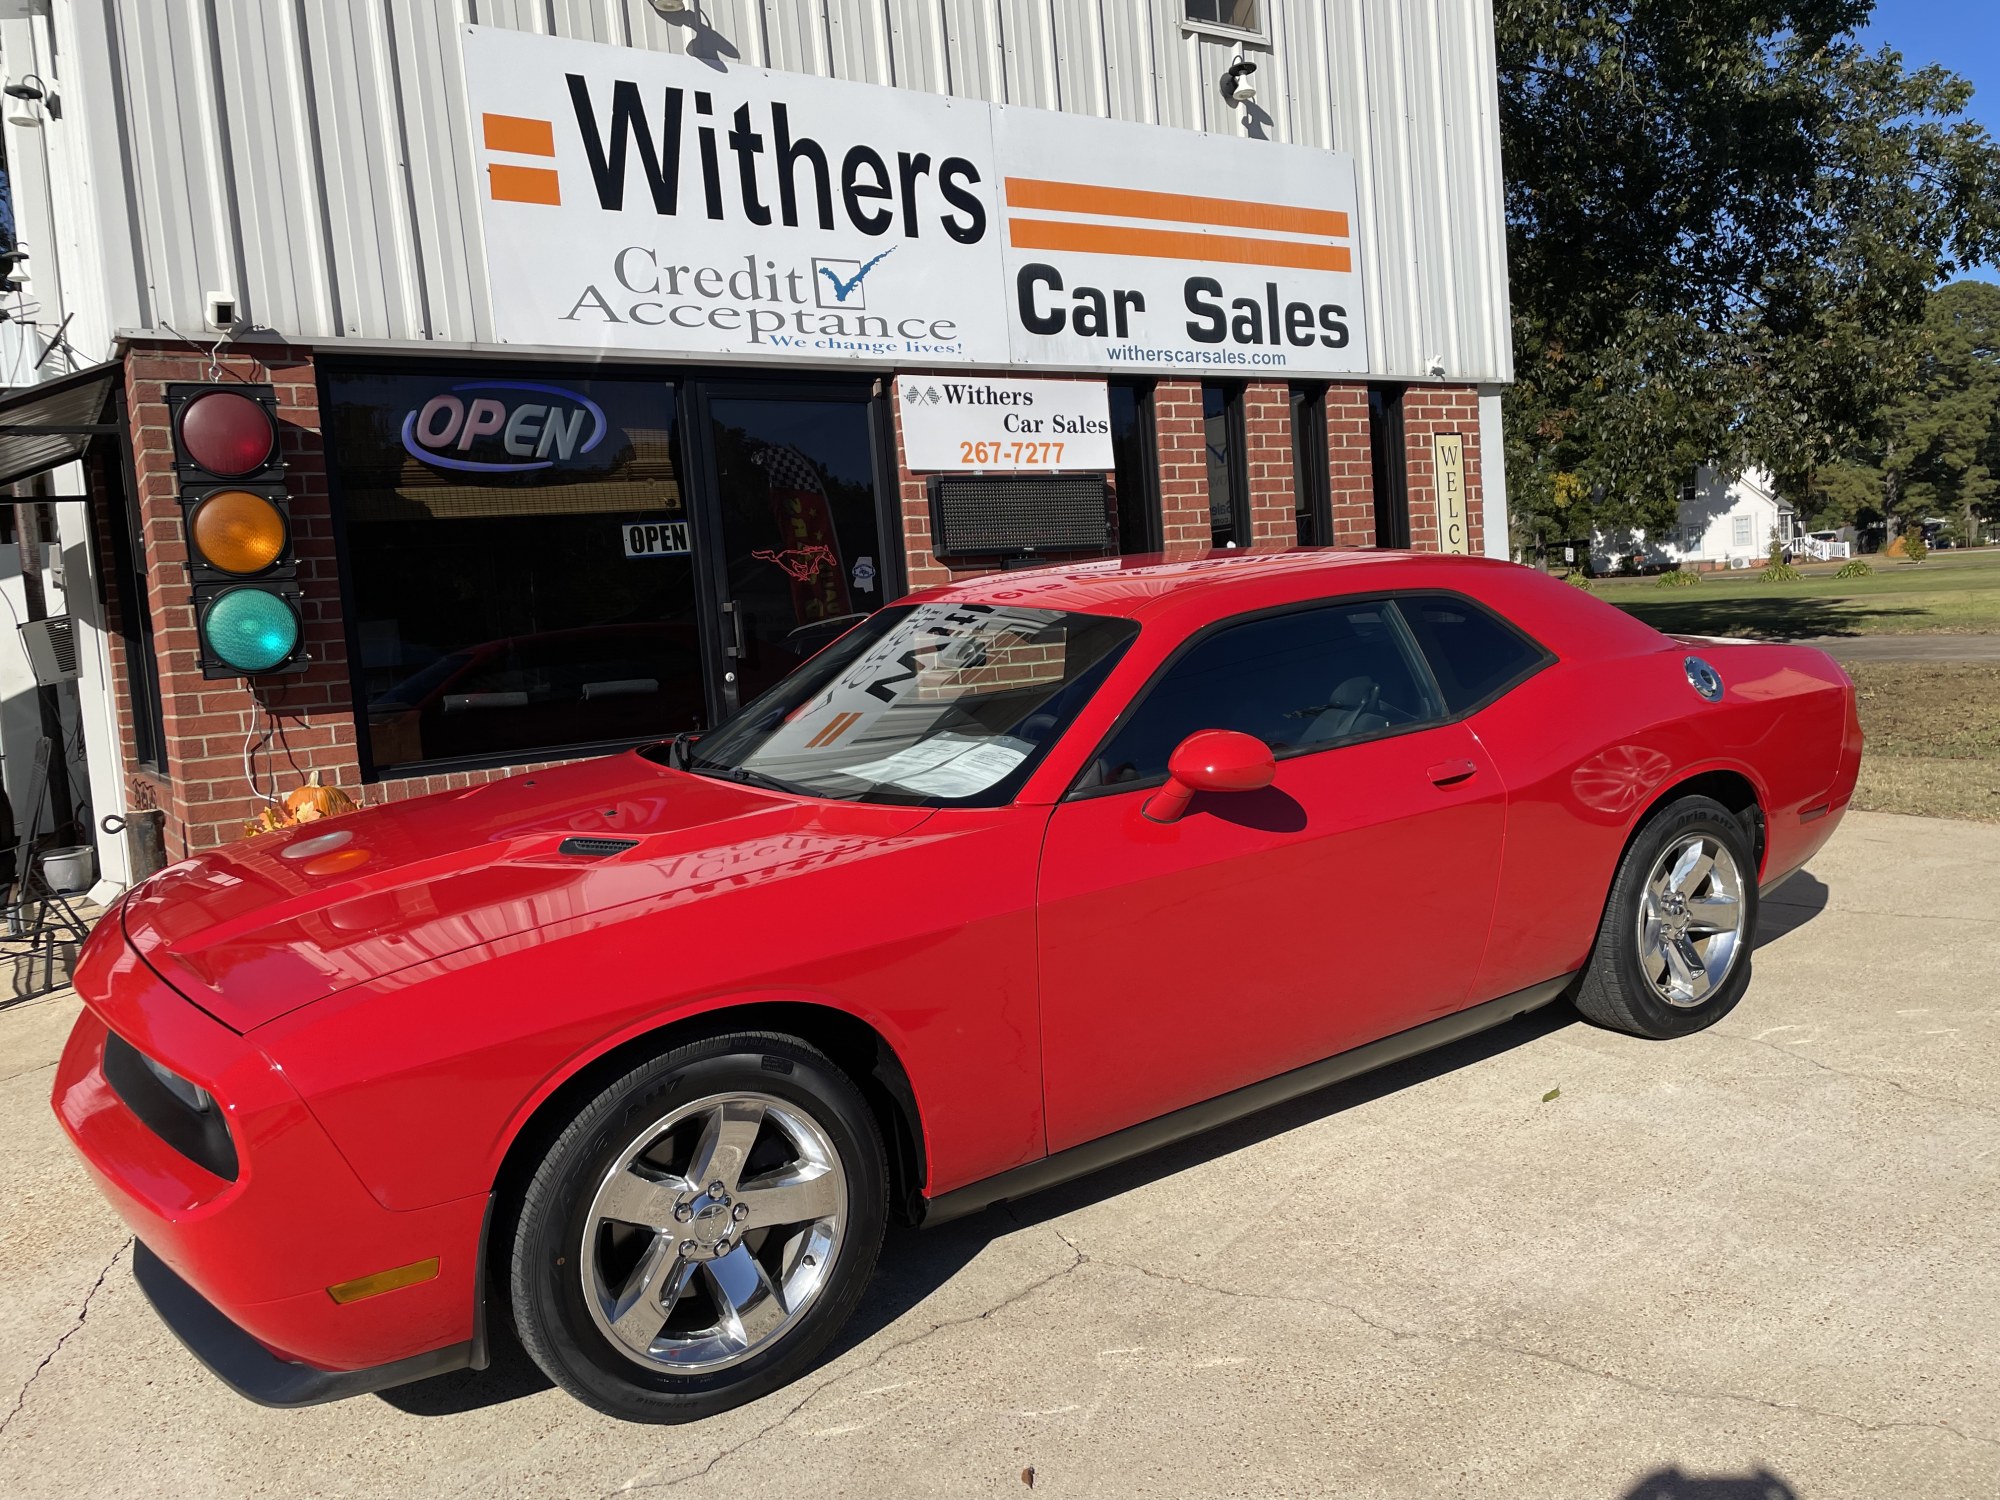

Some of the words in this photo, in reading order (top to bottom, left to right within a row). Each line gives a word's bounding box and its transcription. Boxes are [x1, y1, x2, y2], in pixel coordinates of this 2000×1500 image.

[565, 73, 987, 245] Withers
[613, 246, 808, 304] Credit
[558, 284, 958, 345] Acceptance
[1016, 263, 1146, 338] Car
[1184, 276, 1350, 348] Sales
[769, 334, 807, 348] We
[815, 337, 897, 355] change
[906, 341, 963, 355] lives!
[1106, 345, 1287, 366] witherscarsales.com
[942, 384, 1033, 406] Withers
[416, 394, 587, 461] OPEN
[1003, 413, 1044, 433] Car
[1052, 414, 1109, 434] Sales
[960, 441, 1065, 464] 267-7277
[1440, 445, 1461, 555] WELC
[629, 524, 688, 553] OPEN
